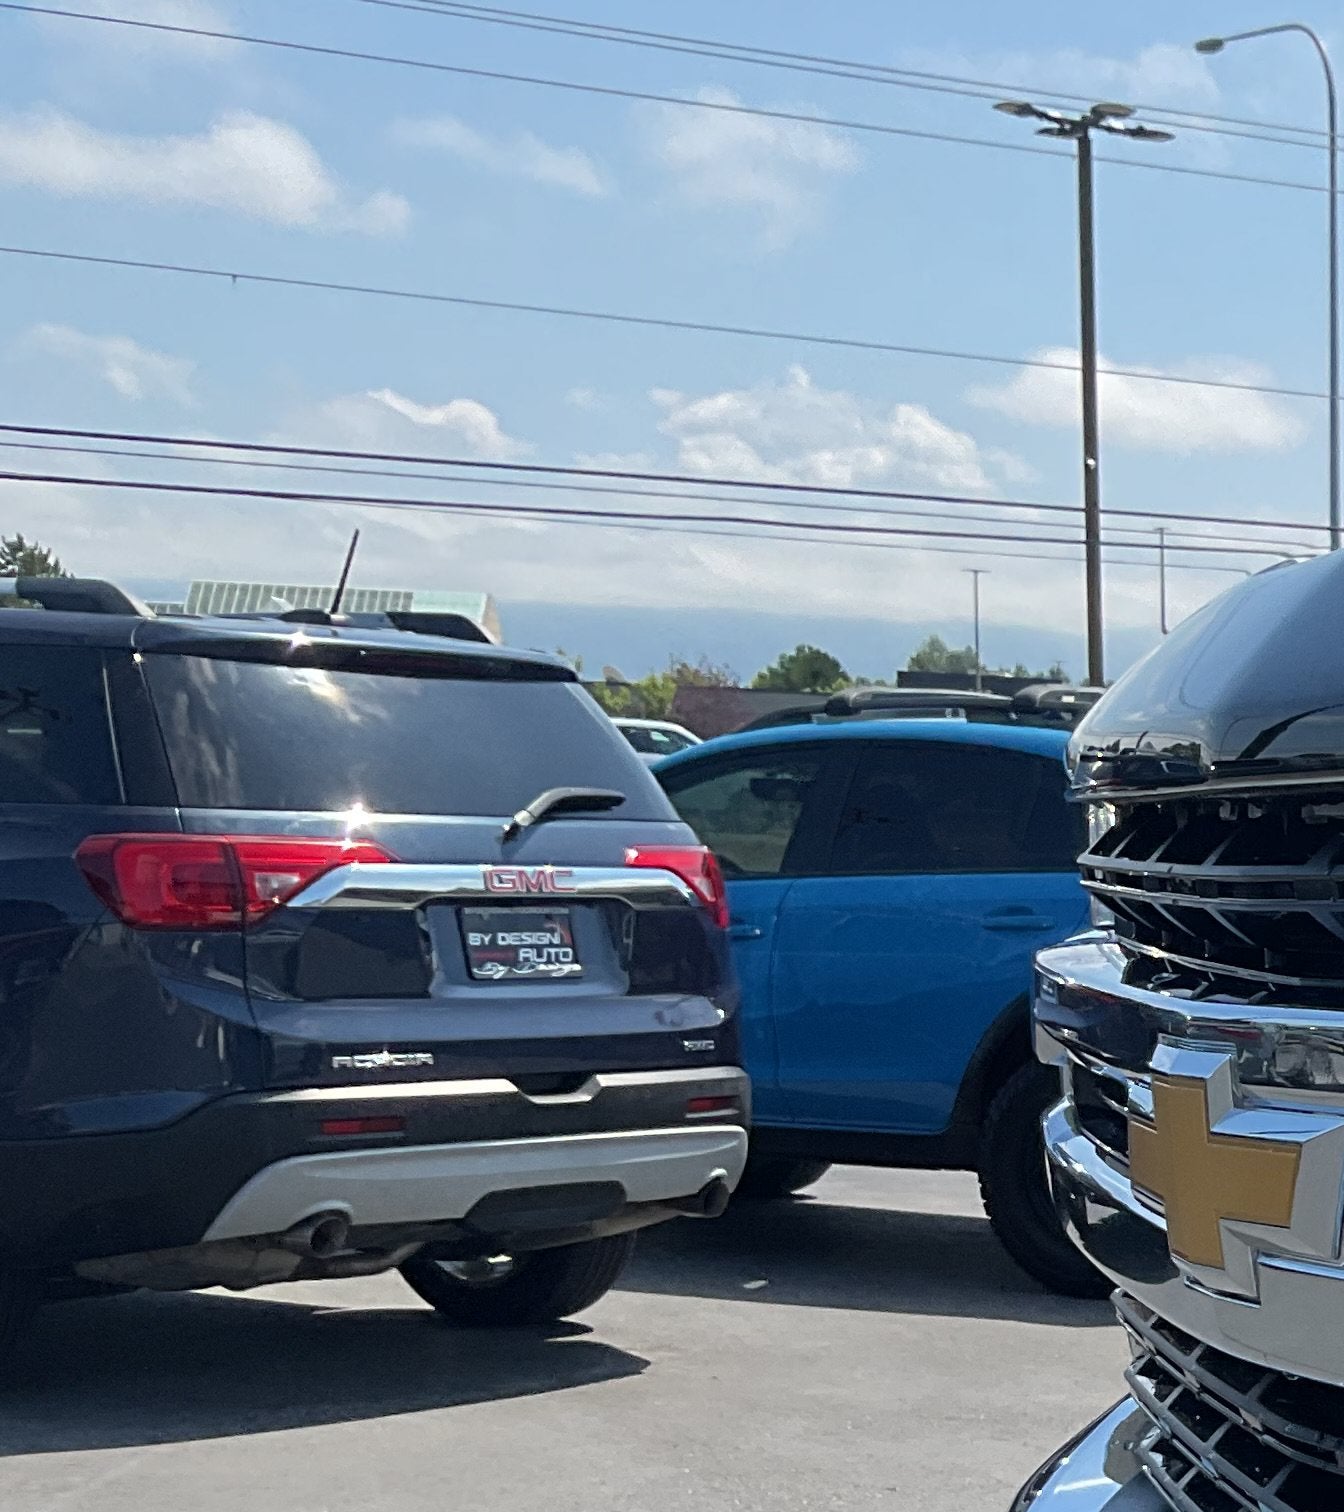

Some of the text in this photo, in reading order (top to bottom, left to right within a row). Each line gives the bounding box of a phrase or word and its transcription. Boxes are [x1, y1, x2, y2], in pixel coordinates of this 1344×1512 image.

[484, 868, 577, 893] GMC
[468, 932, 560, 945] BY DESIGN
[519, 947, 573, 962] AUTO
